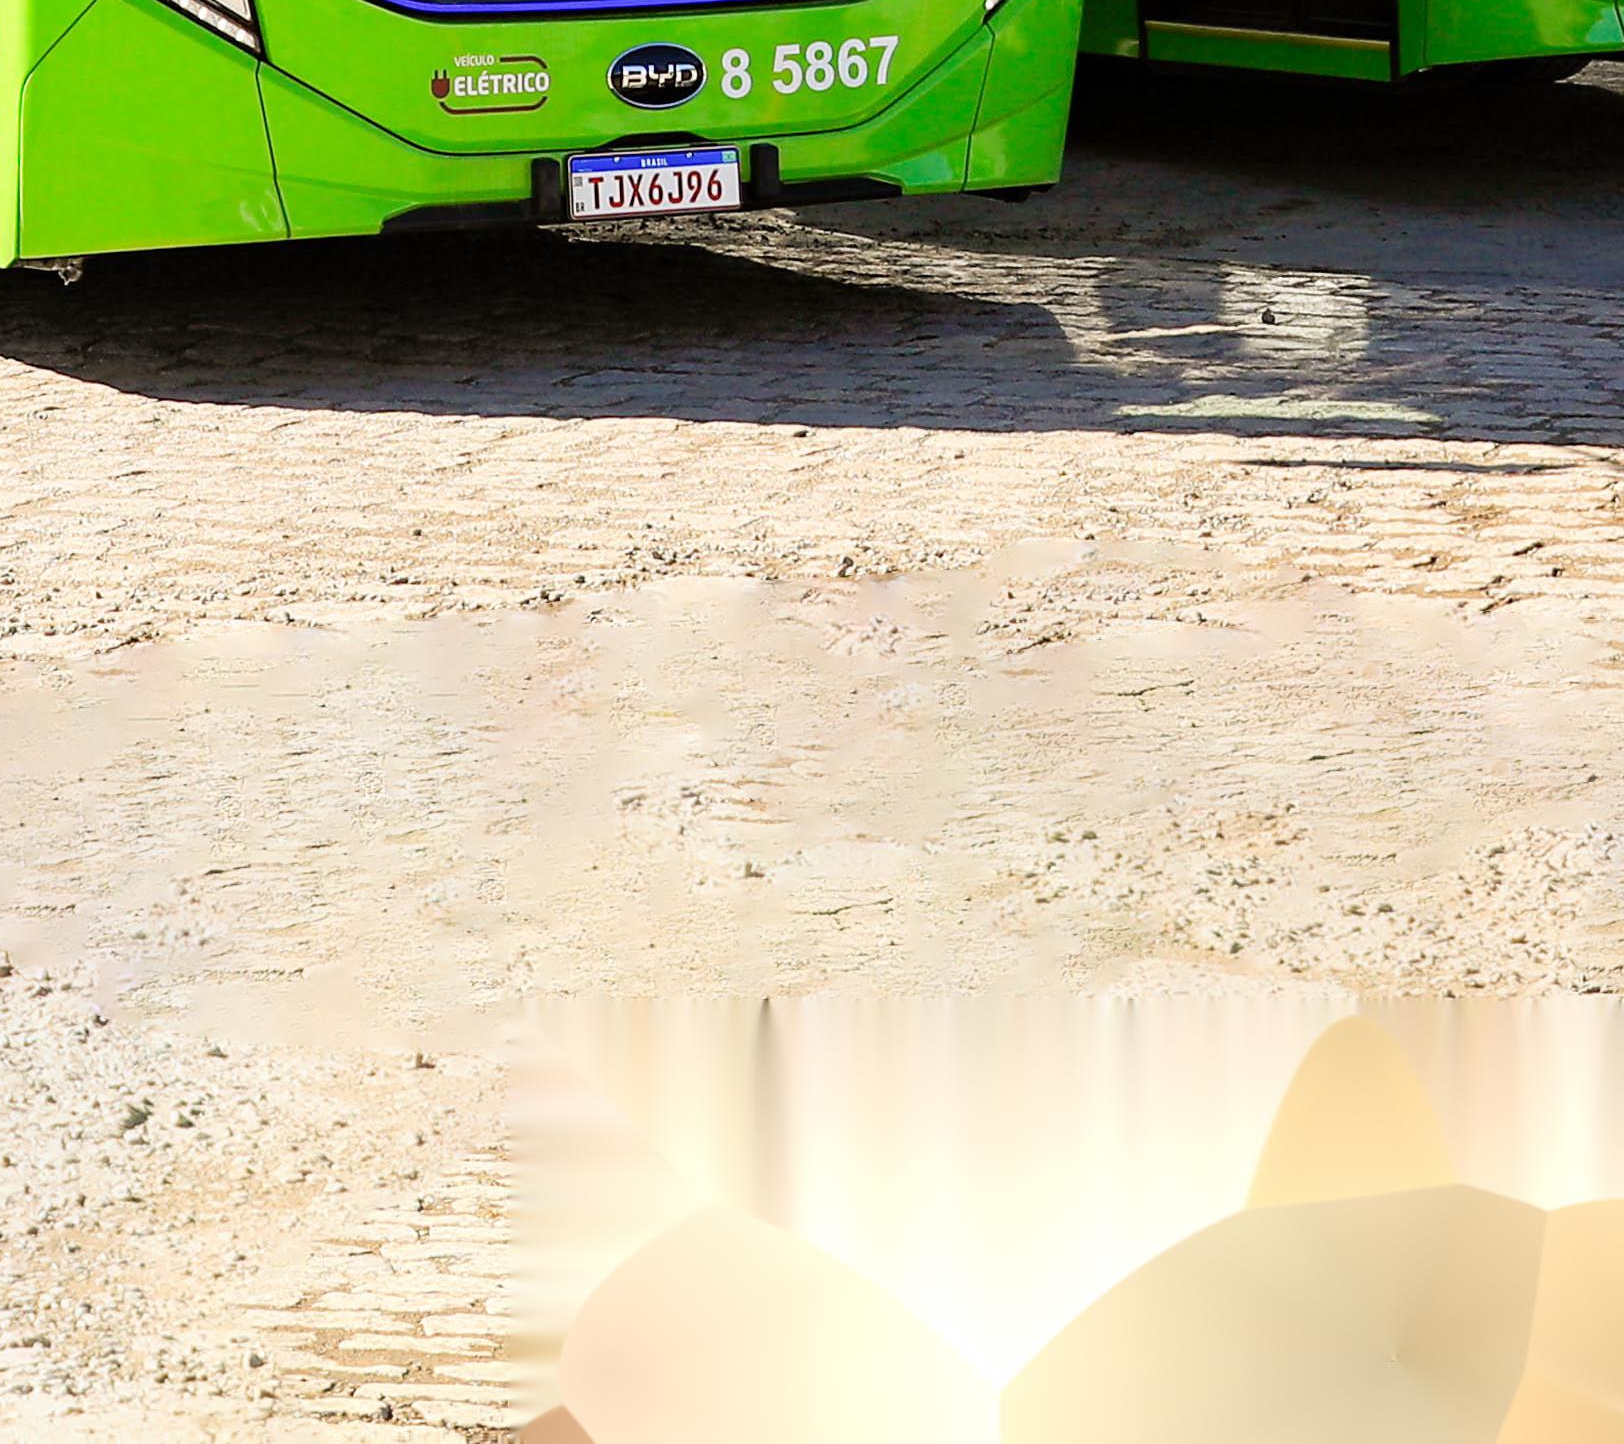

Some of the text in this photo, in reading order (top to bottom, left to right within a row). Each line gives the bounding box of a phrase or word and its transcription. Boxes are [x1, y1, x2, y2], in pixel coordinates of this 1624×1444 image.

[453, 53, 495, 68] VEÍCULO
[720, 34, 901, 100] 8 5867
[453, 70, 551, 99] ELÉTRICO
[621, 64, 698, 90] BYD
[641, 157, 669, 168] BRASIL
[587, 169, 723, 211] TJX6J96
